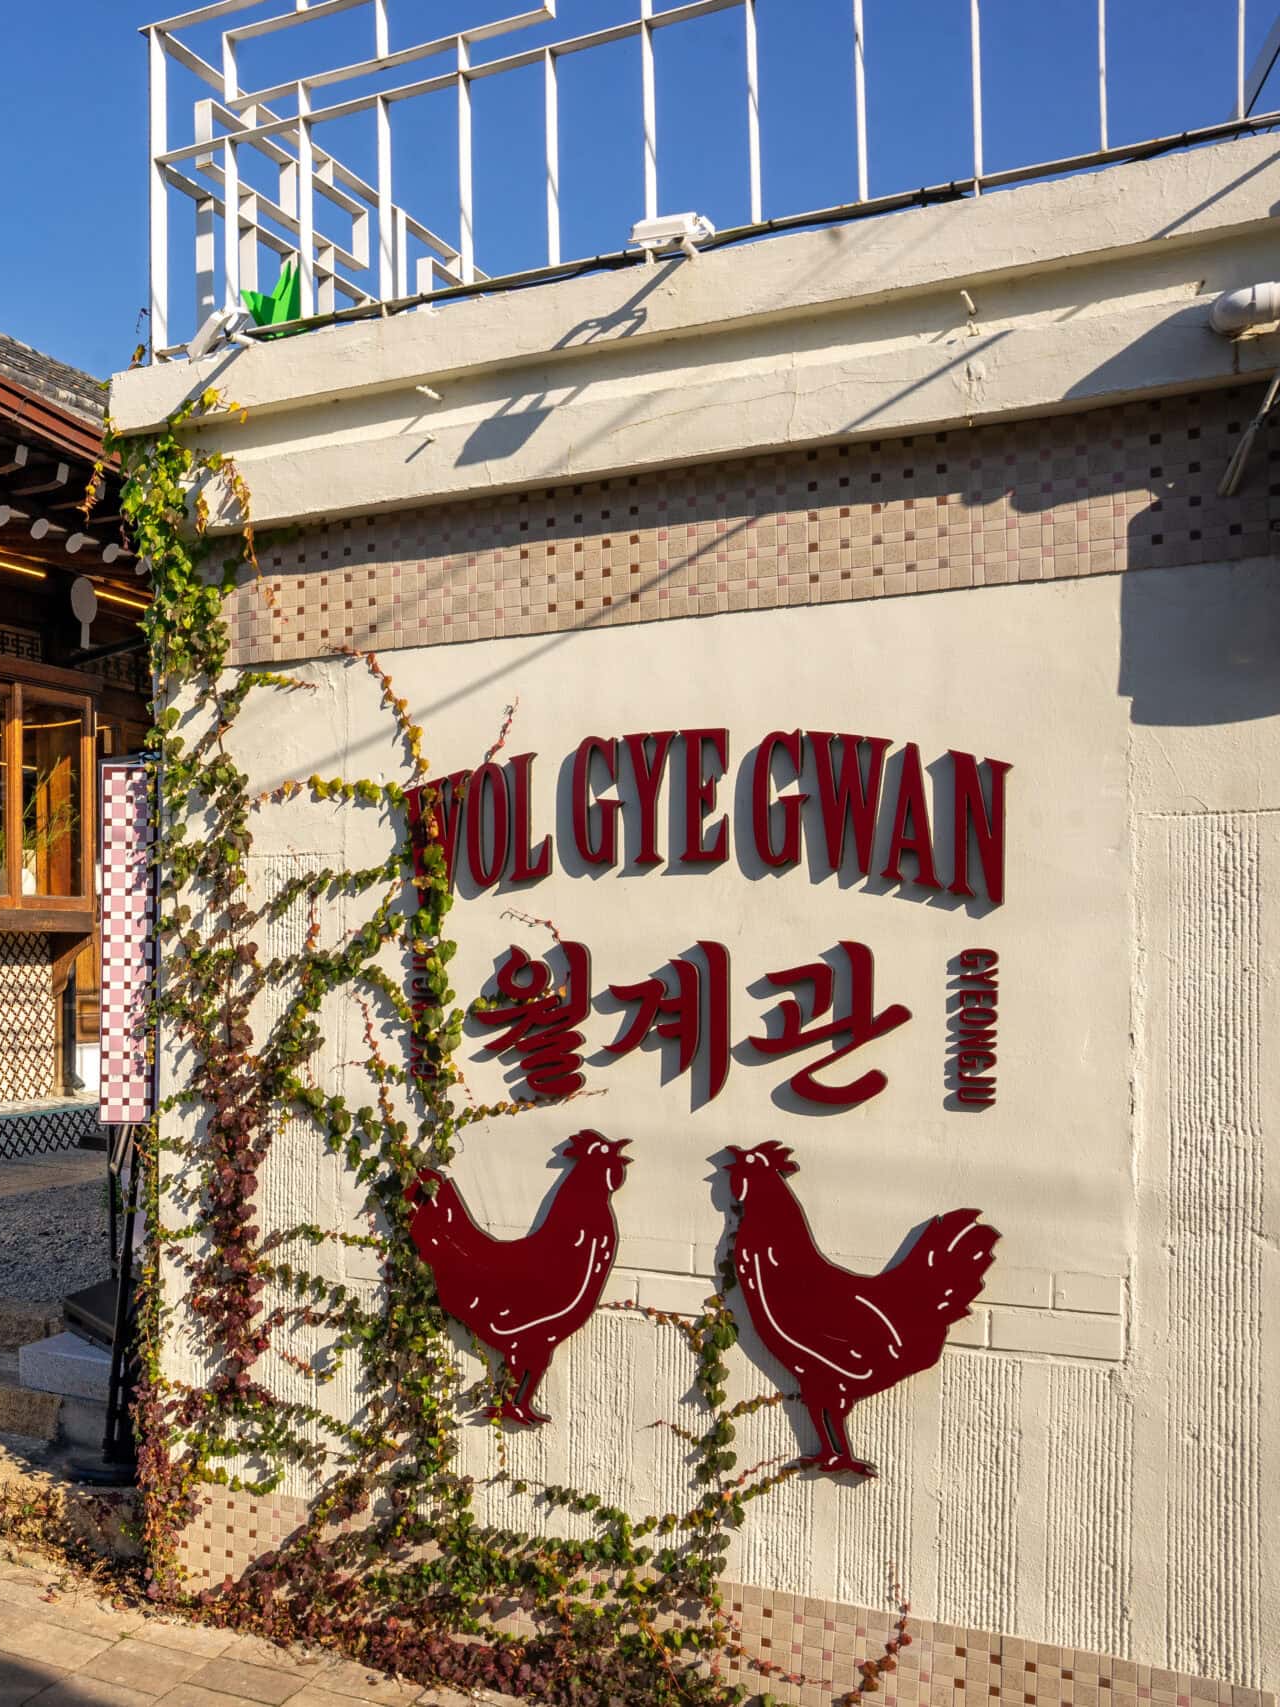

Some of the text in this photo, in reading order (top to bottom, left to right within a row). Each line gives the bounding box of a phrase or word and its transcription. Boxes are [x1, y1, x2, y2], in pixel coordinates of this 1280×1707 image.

[571, 727, 730, 867] GYE
[751, 728, 1014, 905] GWAN
[475, 939, 913, 1106] 월계관
[959, 947, 999, 1106] GYEONGJU
